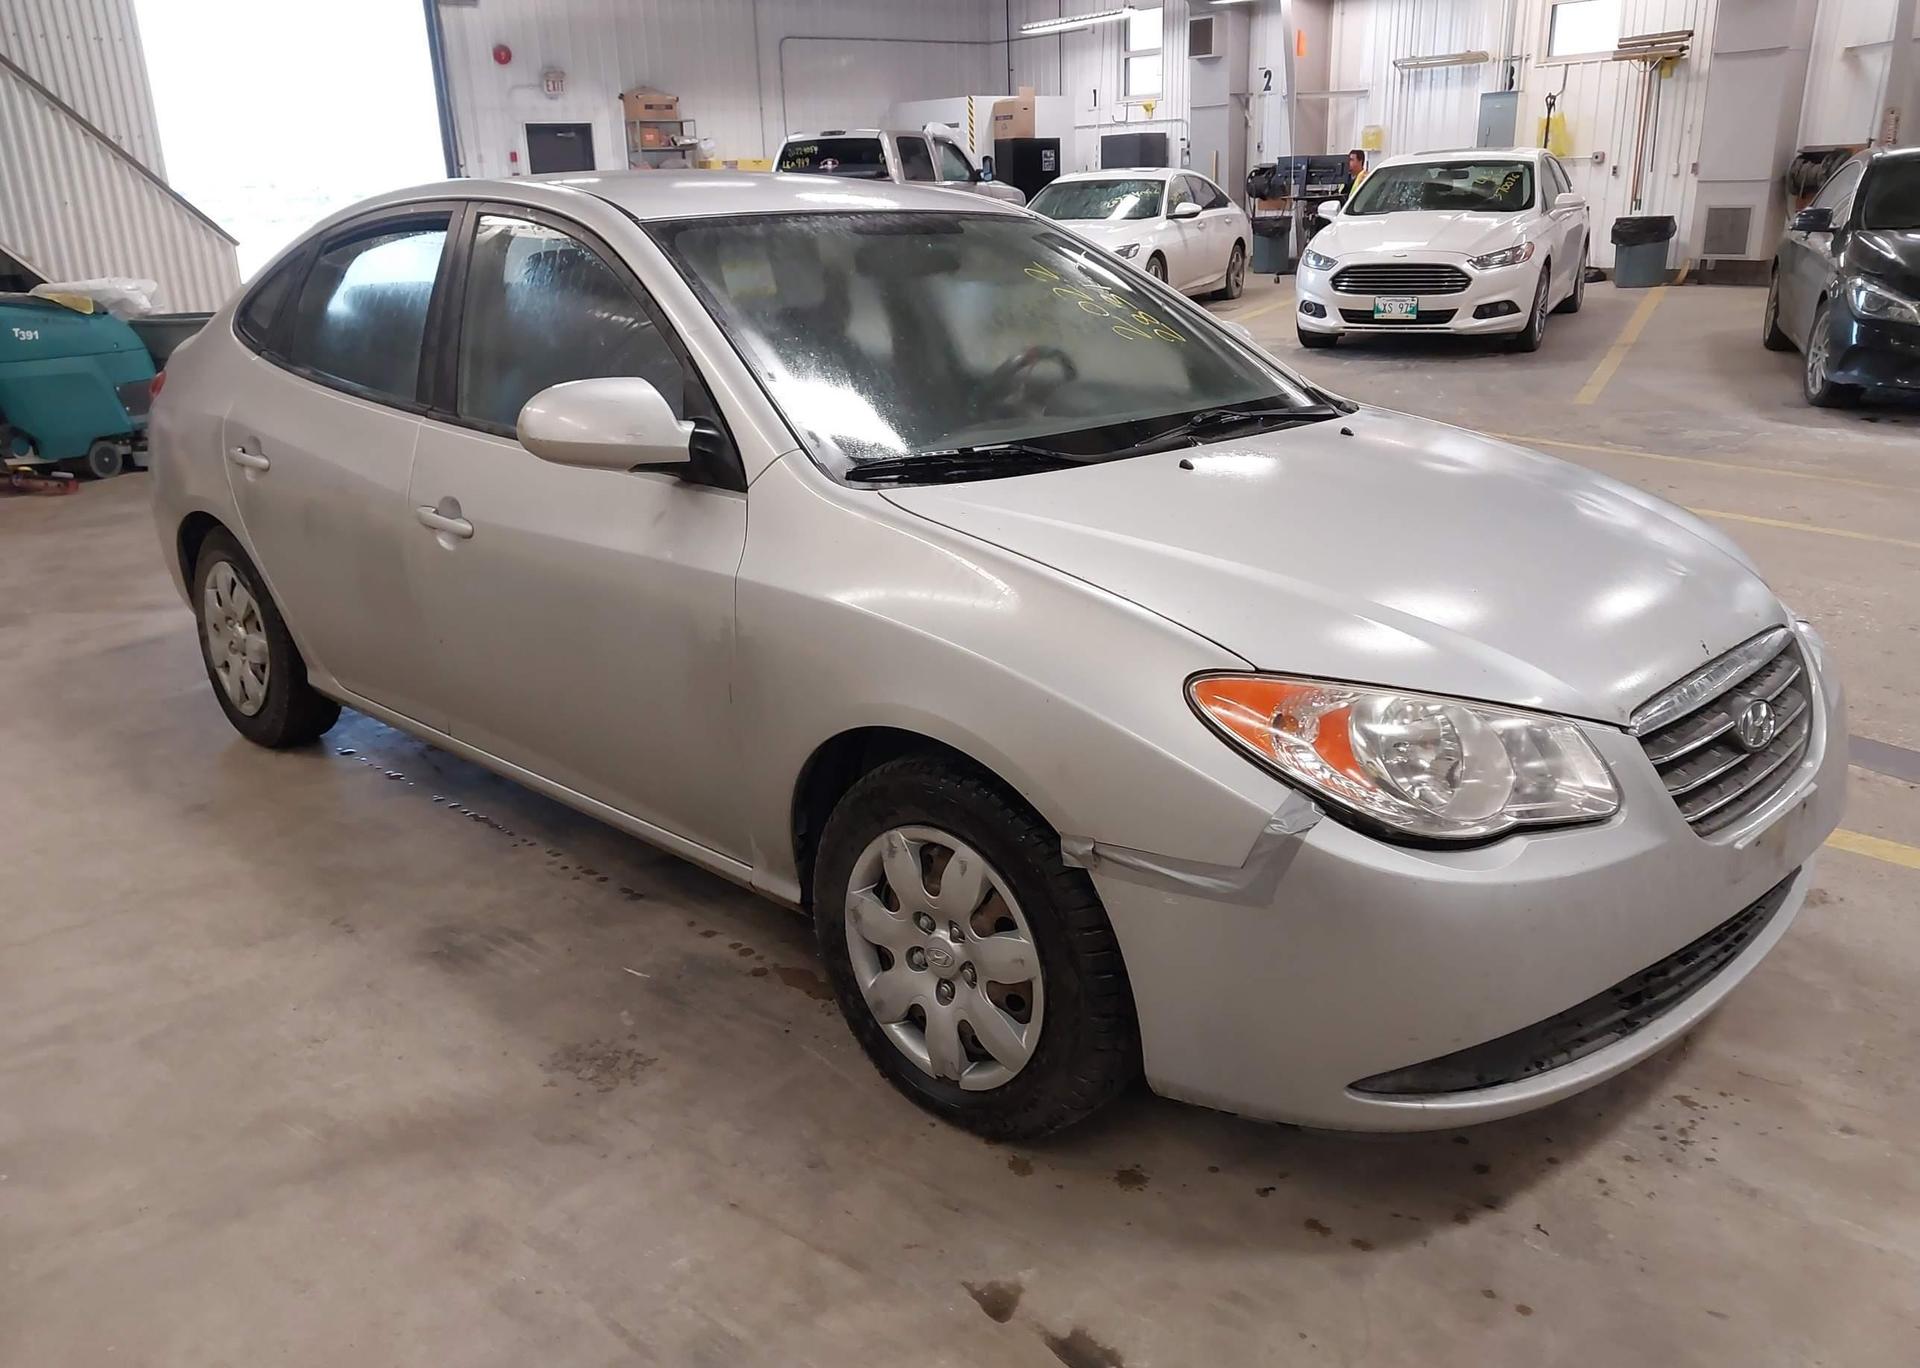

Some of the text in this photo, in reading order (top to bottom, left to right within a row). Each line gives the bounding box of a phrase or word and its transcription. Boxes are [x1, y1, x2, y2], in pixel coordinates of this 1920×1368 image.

[546, 79, 564, 92] EXIT
[1263, 69, 1272, 91] 2
[12, 327, 39, 341] T391
